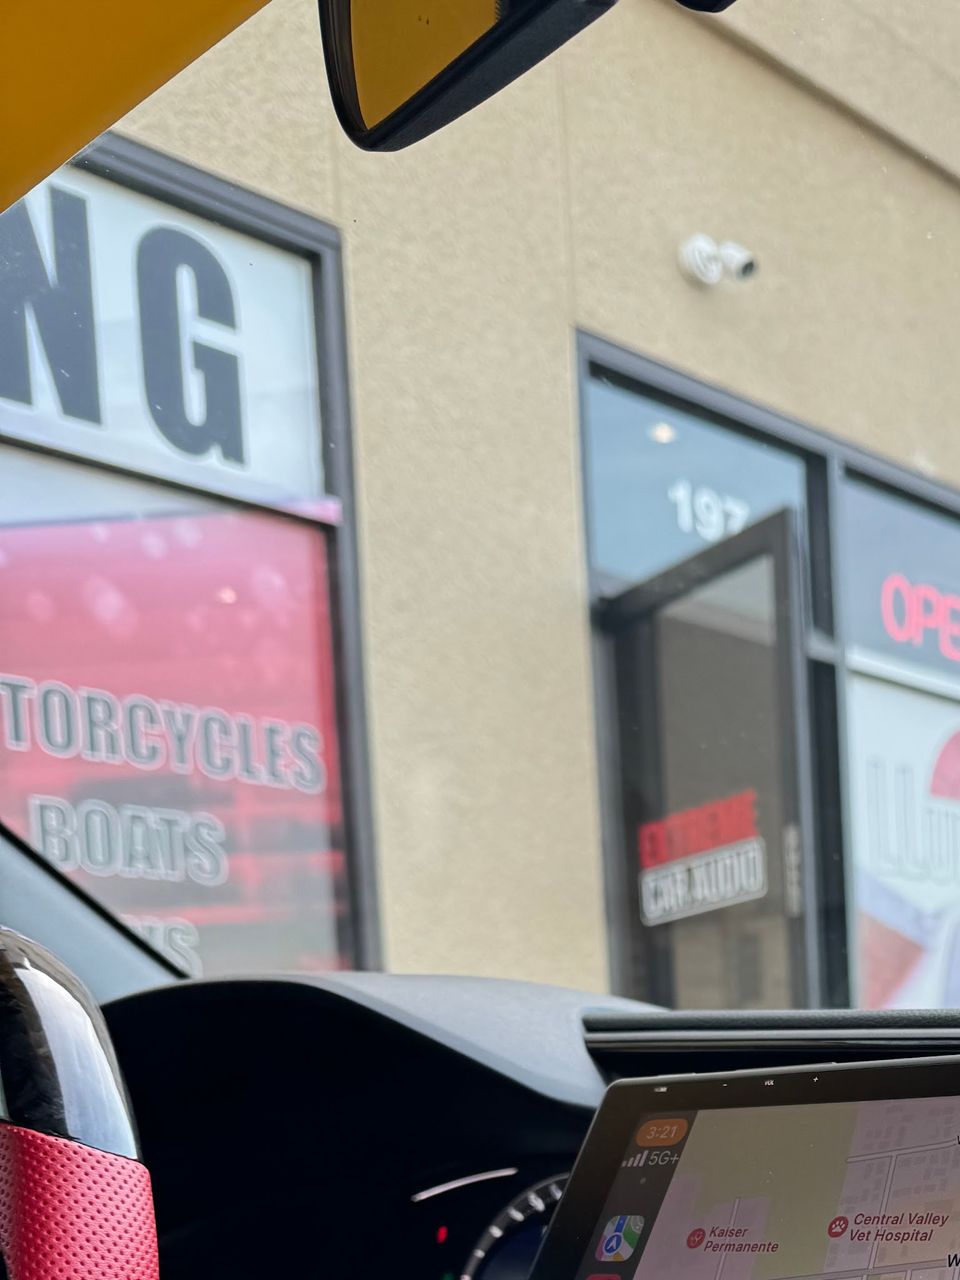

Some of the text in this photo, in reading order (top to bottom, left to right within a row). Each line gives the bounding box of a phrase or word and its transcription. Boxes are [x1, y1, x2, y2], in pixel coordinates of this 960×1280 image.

[29, 793, 228, 886] BOATS
[647, 1124, 678, 1140] 3:21
[648, 1151, 679, 1166] 5G+
[853, 1212, 950, 1227] Central Valley
[709, 1226, 748, 1239] Kaiser
[849, 1228, 933, 1244] Vet Hospital
[703, 1240, 779, 1254] Permanente
